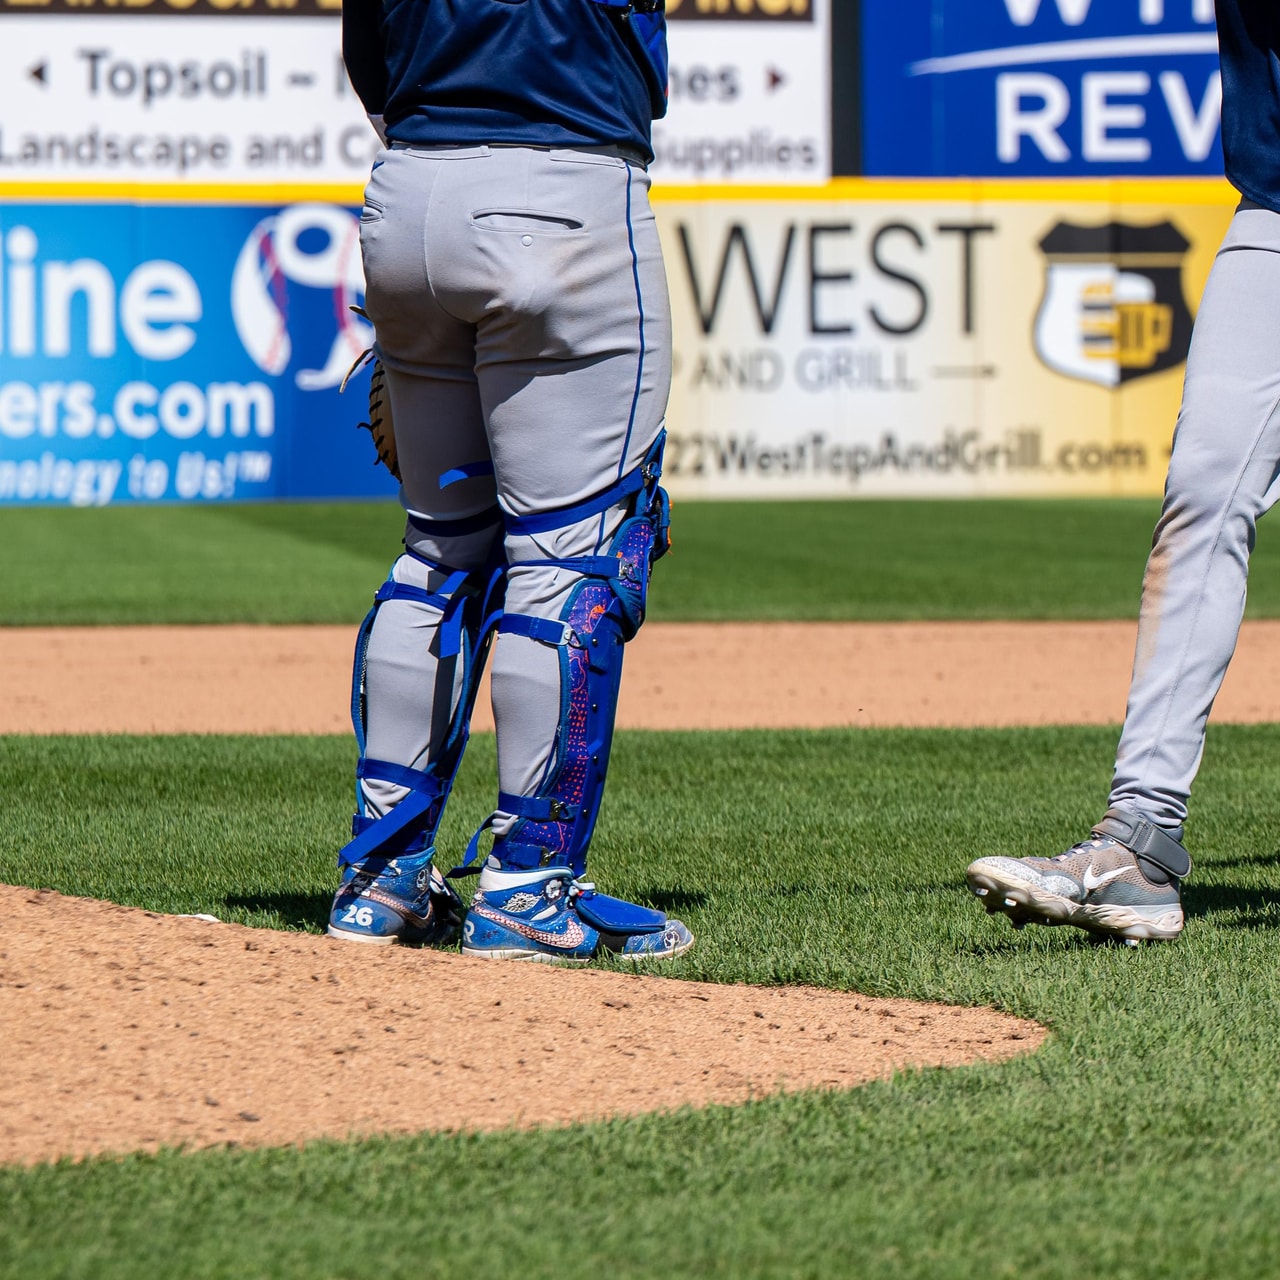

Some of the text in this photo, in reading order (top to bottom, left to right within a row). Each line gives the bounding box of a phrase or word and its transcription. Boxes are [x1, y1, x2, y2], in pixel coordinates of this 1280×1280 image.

[78, 48, 266, 108] Topsoil
[244, 127, 325, 167] and
[676, 218, 998, 338] WEST
[690, 348, 784, 393] AND
[794, 347, 918, 394] GRILL
[127, 453, 170, 499] to
[340, 905, 374, 927] 26
